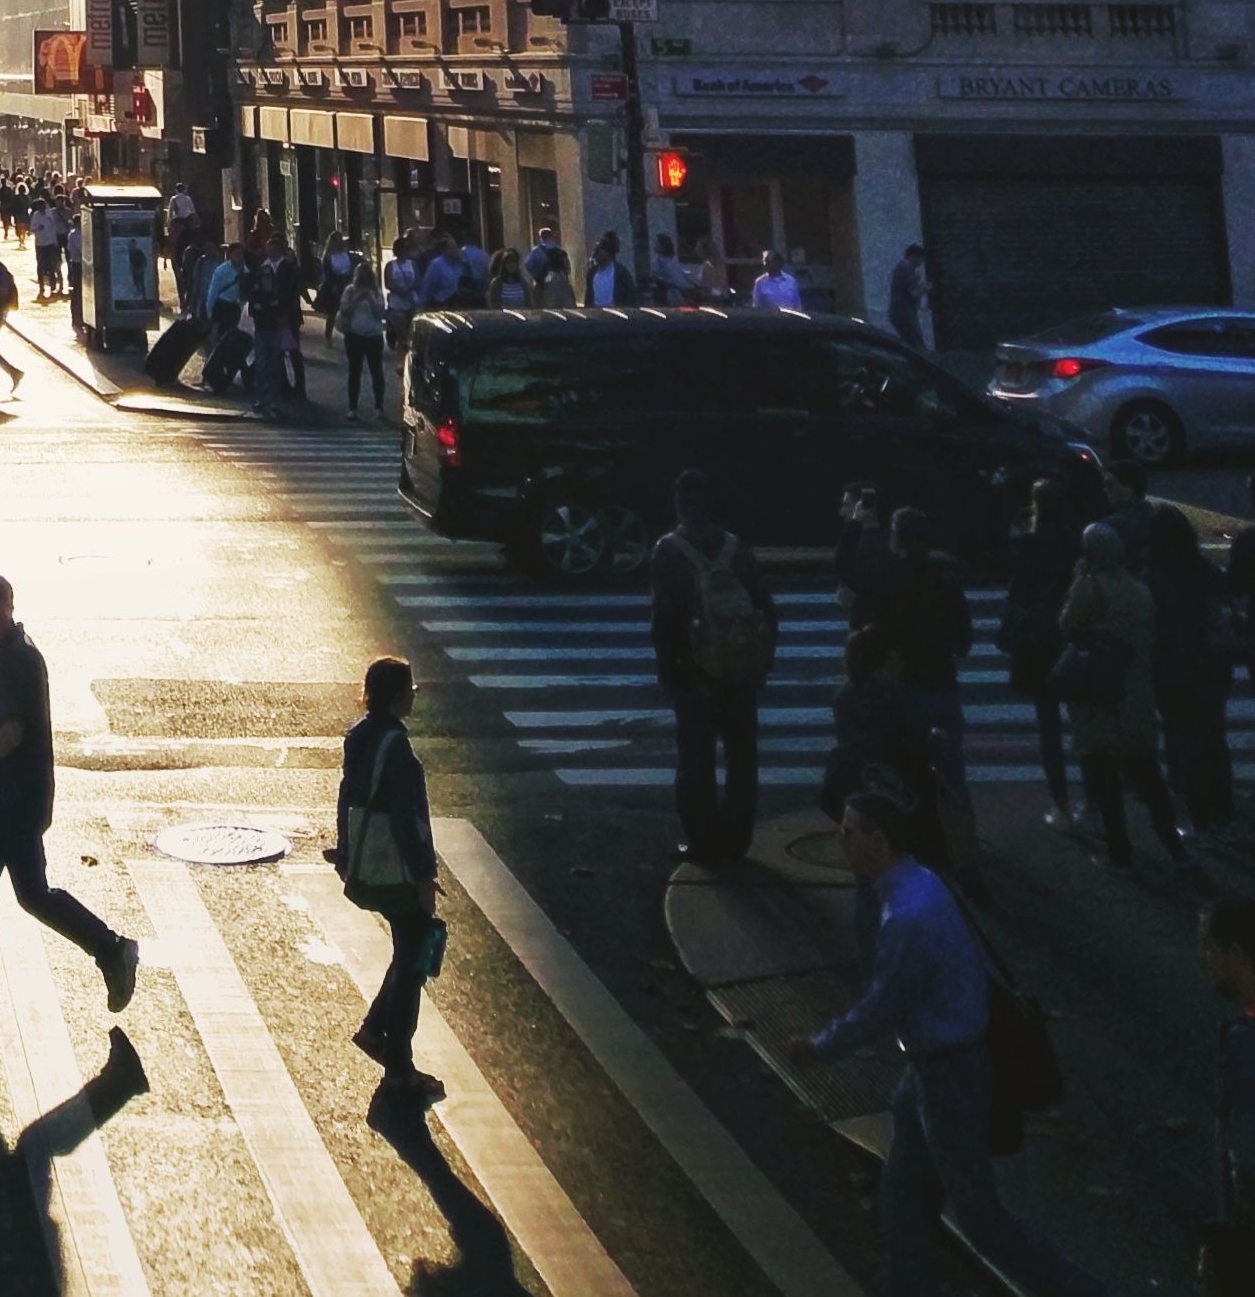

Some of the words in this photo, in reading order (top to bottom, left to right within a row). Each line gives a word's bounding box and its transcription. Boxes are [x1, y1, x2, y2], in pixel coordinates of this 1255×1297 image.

[616, 9, 651, 19] BUSES
[693, 78, 725, 92] Bank
[727, 78, 740, 92] of
[742, 78, 795, 92] America
[959, 76, 1049, 97] BRYANT
[1057, 77, 1172, 97] CAMERAS
